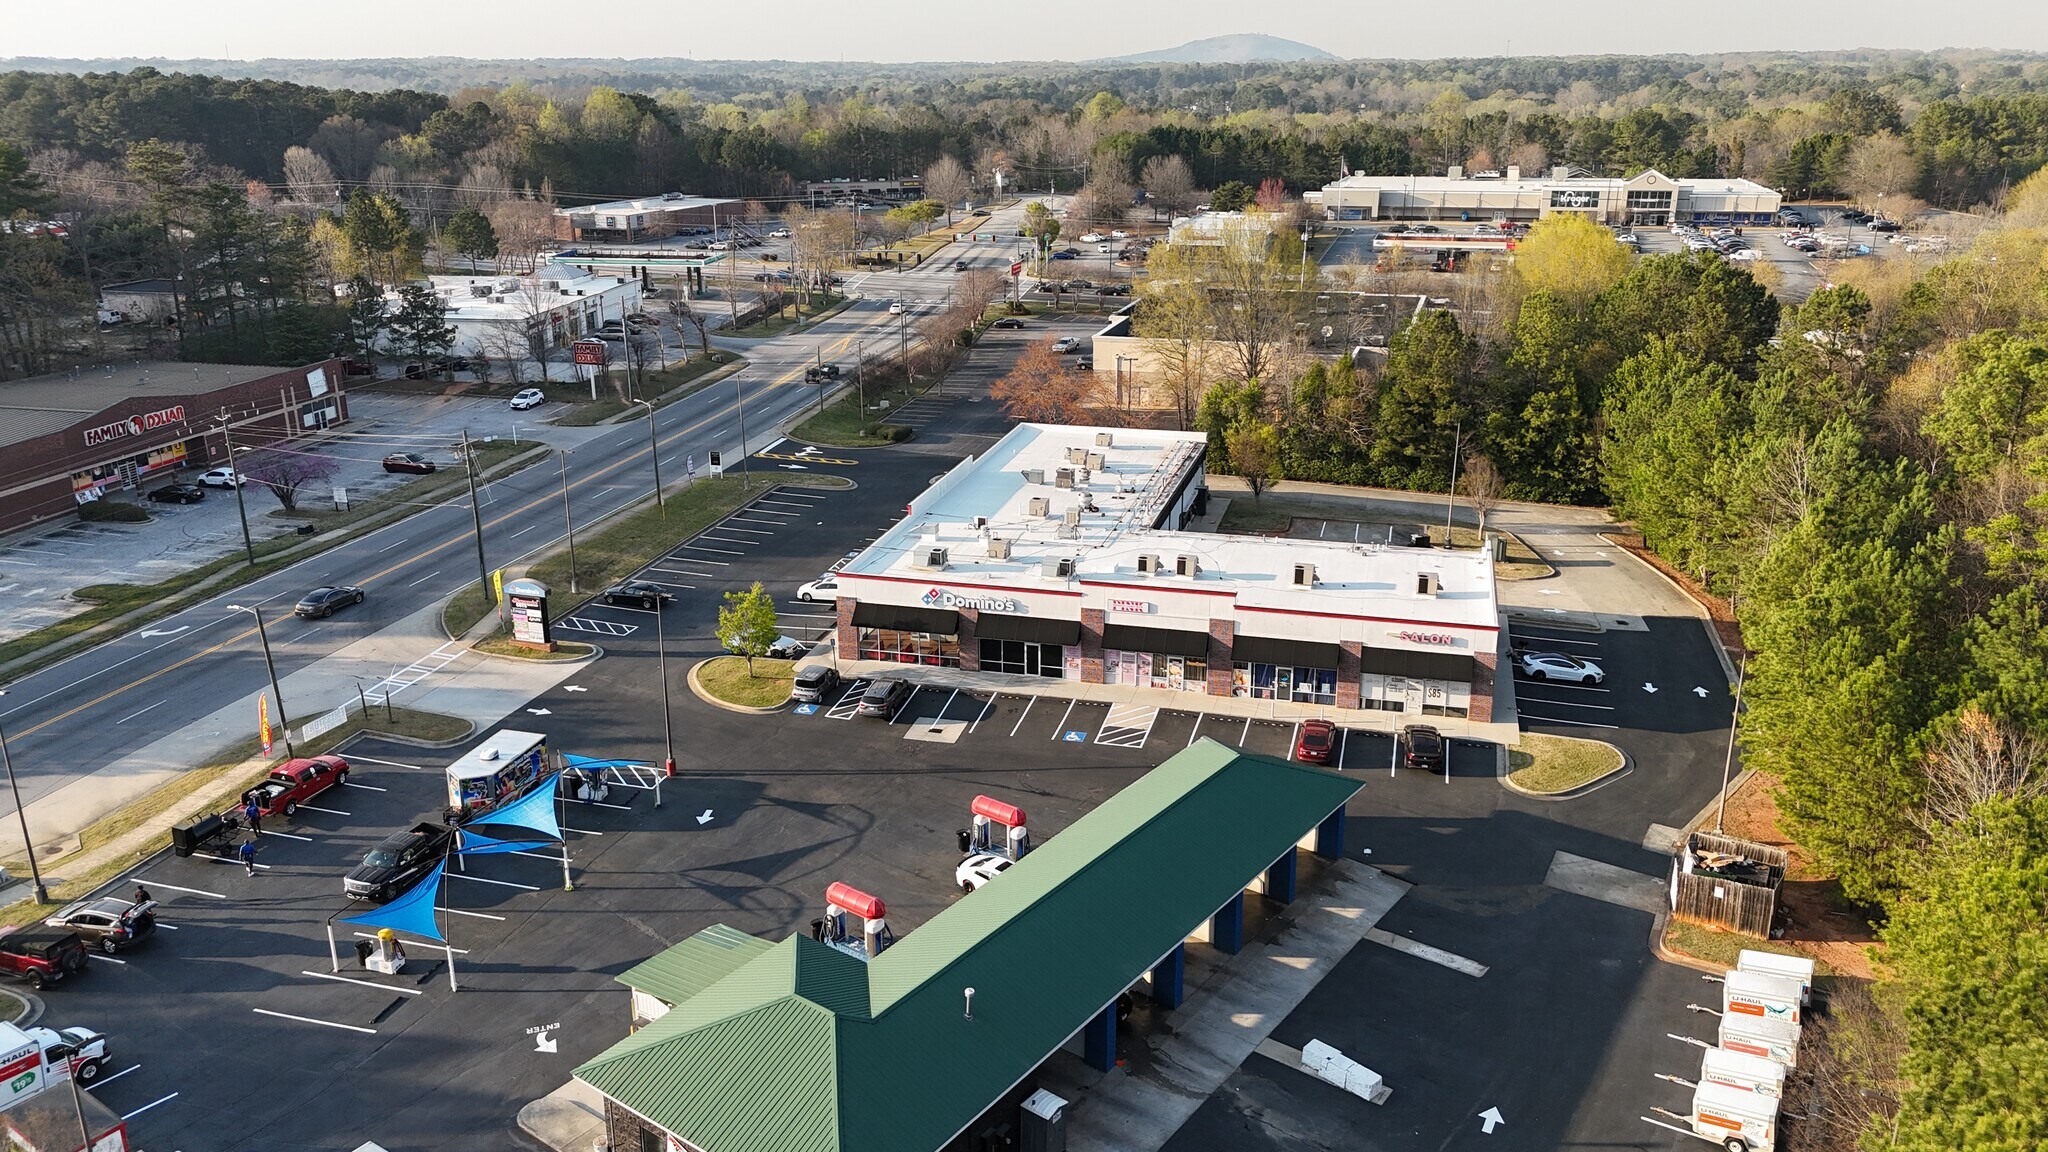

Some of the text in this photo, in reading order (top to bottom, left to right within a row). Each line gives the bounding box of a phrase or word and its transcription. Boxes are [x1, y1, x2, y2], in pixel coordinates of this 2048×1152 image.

[1560, 191, 1590, 207] Kroger
[576, 344, 600, 353] FAMILY
[85, 405, 185, 446] FAMILY DOLLAR
[943, 592, 1015, 612] Domino's
[1400, 630, 1452, 646] SALON
[1427, 687, 1442, 699] $85
[525, 1022, 561, 1035] ENTER
